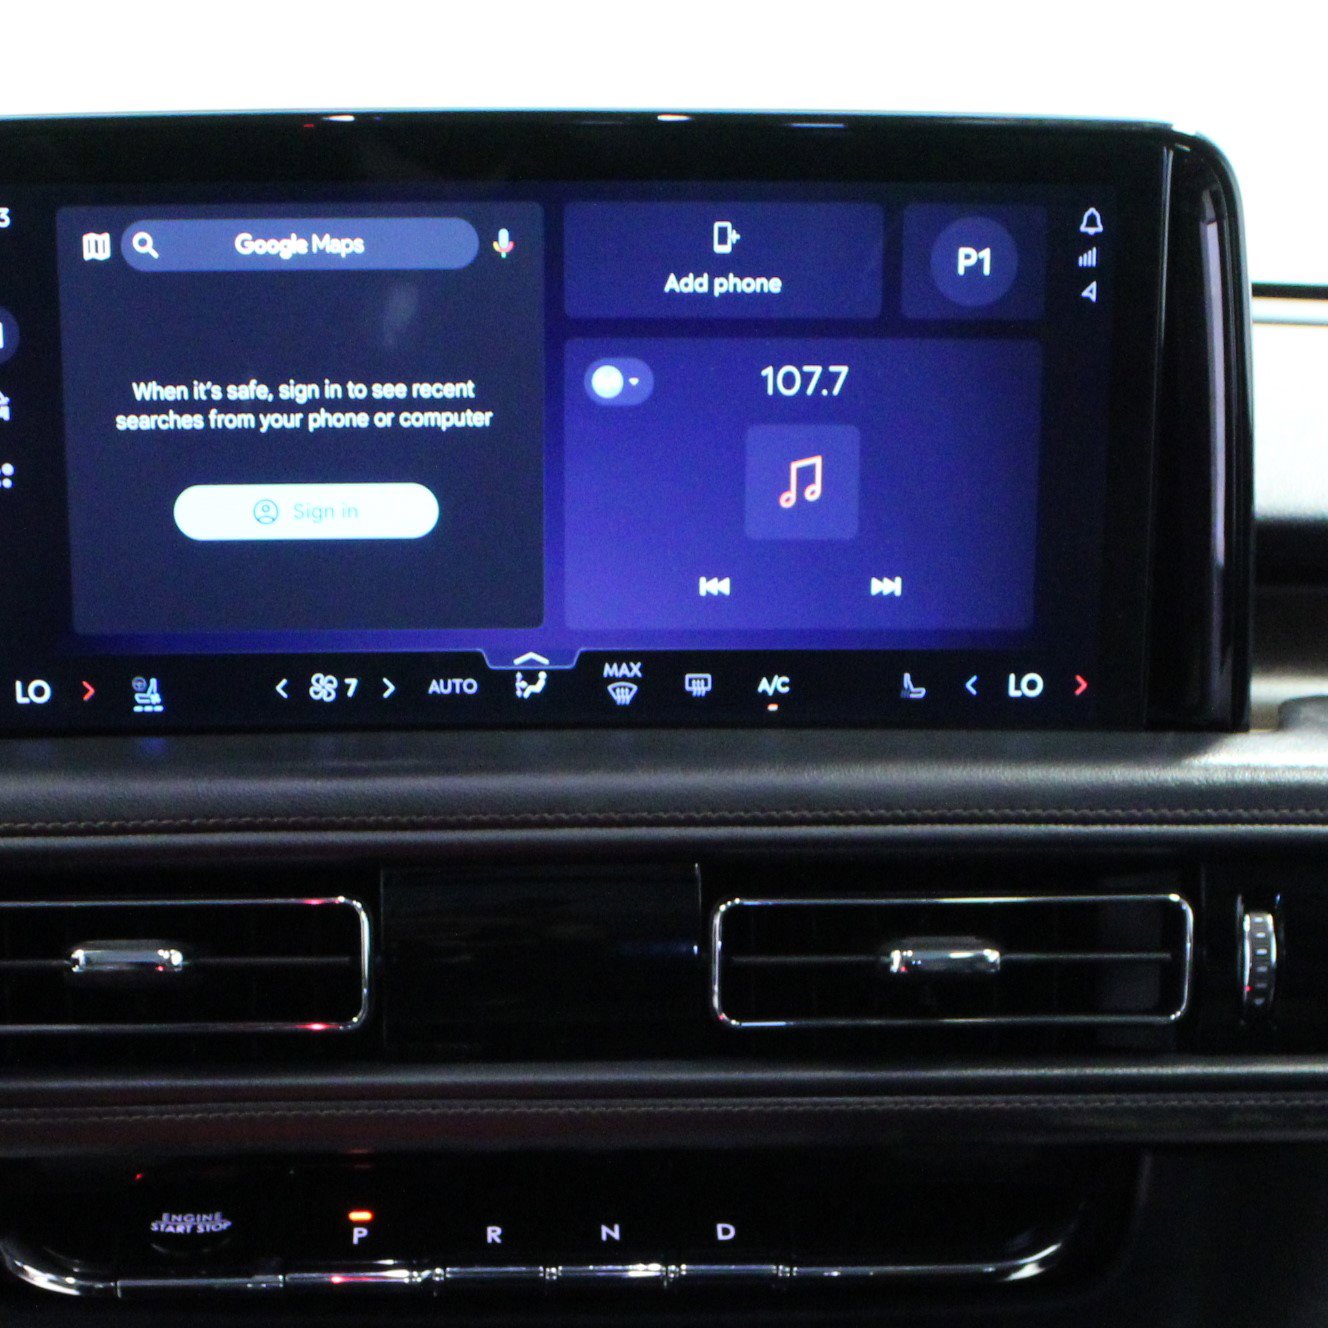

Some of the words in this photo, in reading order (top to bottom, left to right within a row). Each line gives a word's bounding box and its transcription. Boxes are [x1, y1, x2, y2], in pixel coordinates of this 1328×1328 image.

[234, 232, 309, 261] Google
[311, 233, 365, 259] Maps
[957, 246, 992, 277] P1
[663, 272, 709, 294] Add
[713, 272, 783, 299] phone
[131, 380, 189, 402] When
[193, 380, 223, 401] it's
[226, 378, 274, 403] safe,
[278, 379, 320, 405] sign
[324, 378, 343, 400] in
[346, 380, 368, 400] to
[371, 382, 408, 400] see
[411, 379, 476, 400] recent
[760, 364, 850, 397] 107.7
[115, 408, 205, 431] searches
[208, 408, 256, 430] from
[258, 412, 304, 434] your
[308, 407, 370, 433] phone
[373, 411, 396, 429] or
[398, 408, 494, 433] computer
[293, 502, 335, 524] Sign
[341, 501, 360, 520] in
[602, 661, 643, 679] MAX
[15, 679, 53, 705] LO
[344, 677, 359, 698] 7
[427, 678, 479, 695] AUTO
[757, 674, 791, 696] A/C
[1007, 672, 1045, 699] LO
[150, 1221, 193, 1234] START
[195, 1219, 233, 1234] STOP
[161, 1211, 224, 1223] ENGINE
[350, 1226, 369, 1245] P
[486, 1225, 504, 1244] R
[600, 1223, 622, 1242] N
[716, 1223, 736, 1241] D
